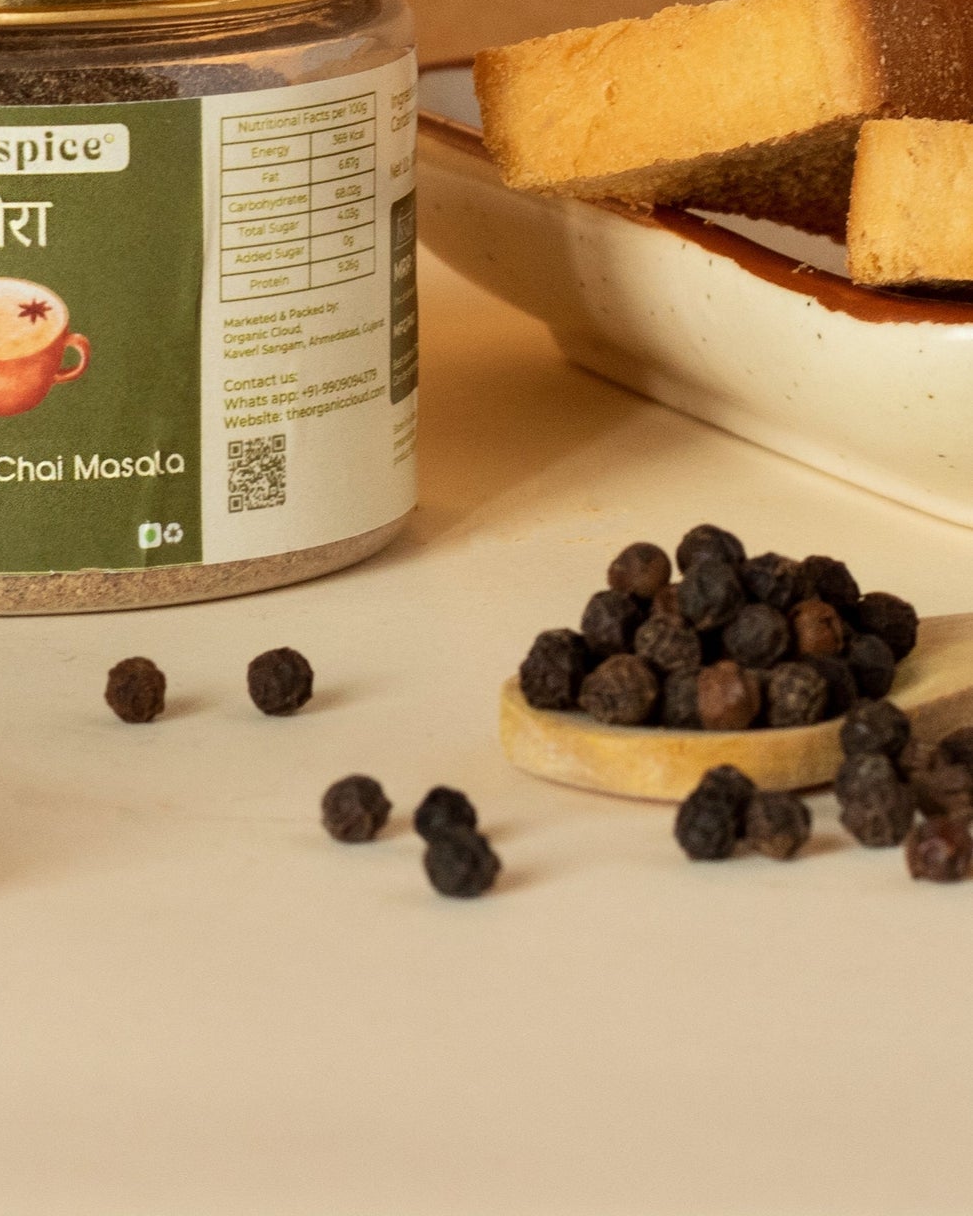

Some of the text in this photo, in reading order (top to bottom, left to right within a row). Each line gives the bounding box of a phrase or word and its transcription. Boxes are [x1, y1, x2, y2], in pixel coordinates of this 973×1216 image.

[237, 113, 300, 133] Nutritional
[302, 109, 330, 125] Facts
[331, 107, 347, 121] per
[250, 144, 291, 160] Energy
[261, 170, 280, 184] Fat
[227, 193, 309, 214] Carbohydrates
[237, 220, 300, 238] Total Sugar
[234, 244, 306, 264] Added Sugar
[249, 274, 290, 291] Protein
[223, 312, 277, 330] Marketed
[278, 310, 287, 322] &
[288, 304, 325, 320] Packed
[222, 328, 269, 345] Organic
[223, 343, 260, 360] Kaveri
[223, 374, 277, 393] Contact
[223, 395, 269, 411] Whats
[223, 412, 284, 430] Website:
[74, 450, 185, 481] Masala
